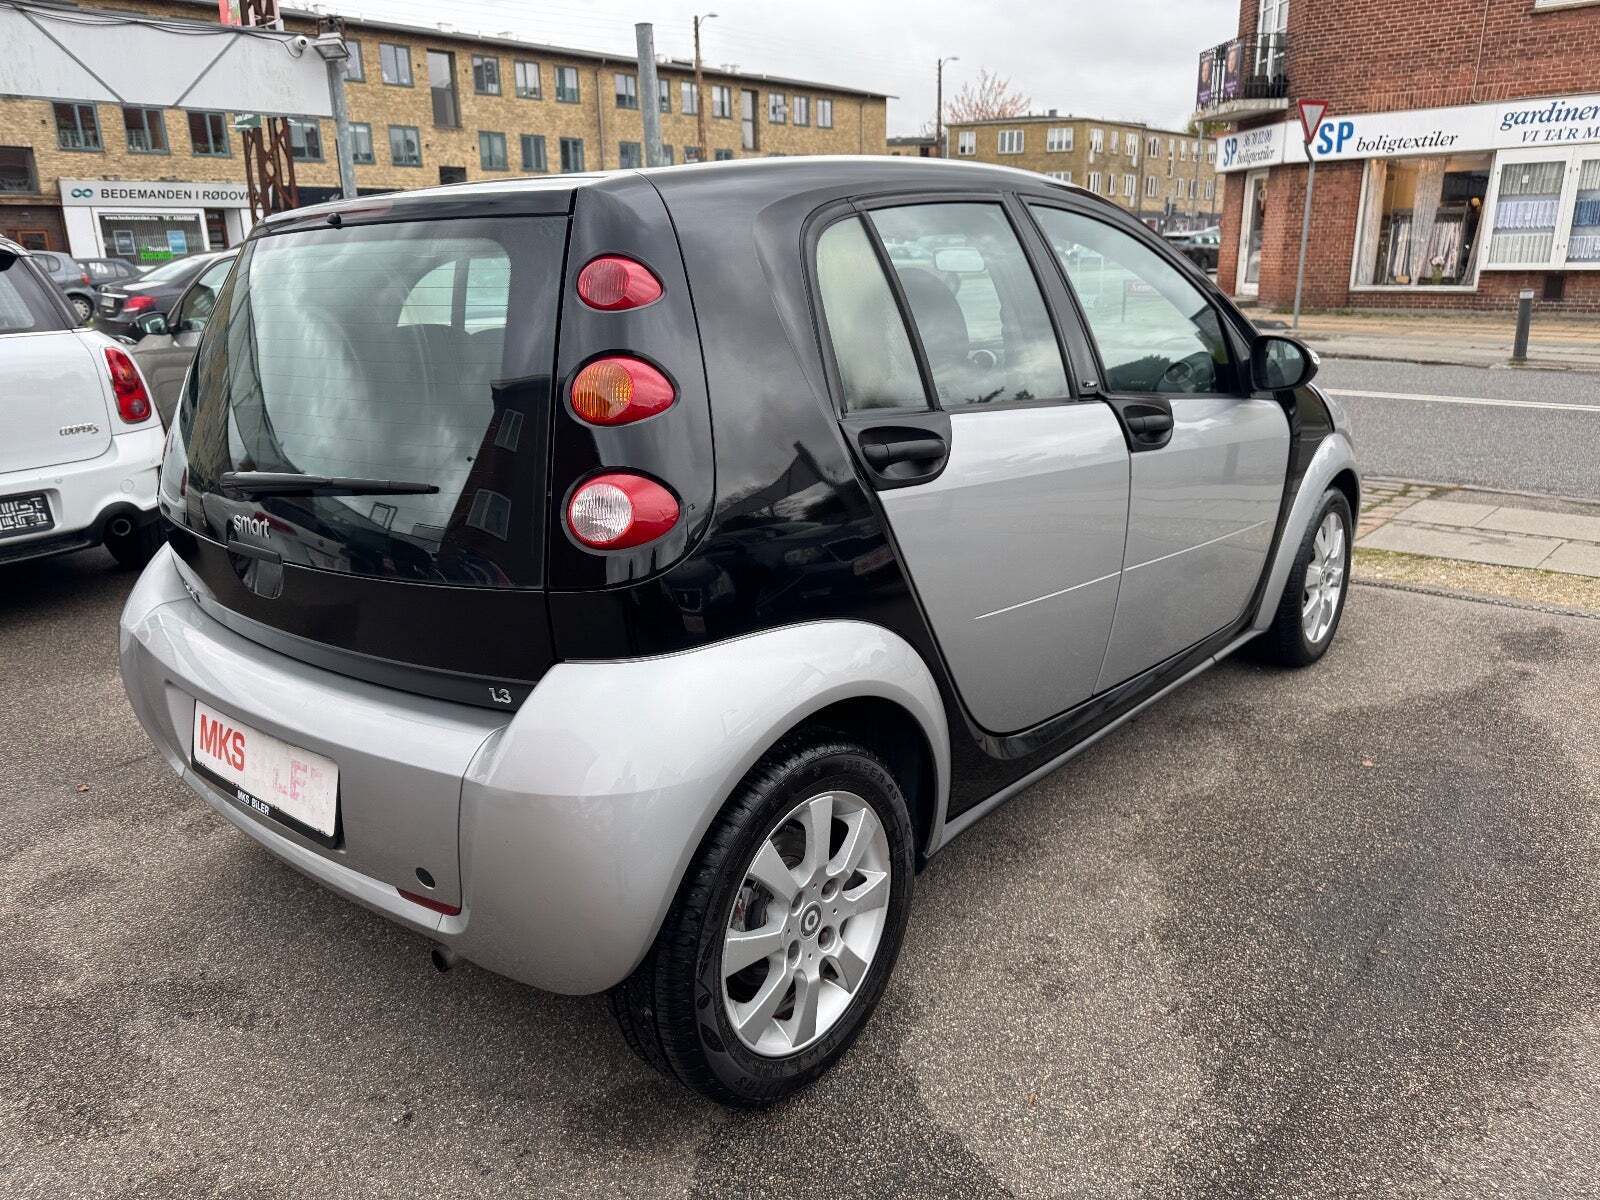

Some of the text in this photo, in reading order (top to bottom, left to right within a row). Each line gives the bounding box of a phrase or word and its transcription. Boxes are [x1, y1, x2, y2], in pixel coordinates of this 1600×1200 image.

[1317, 121, 1459, 155] SP boligtextiler
[1522, 130, 1540, 143] VI
[1223, 138, 1238, 167] SP
[100, 188, 192, 200] BEDEMANDEN
[233, 514, 270, 538] smart
[200, 713, 246, 772] MKS
[237, 789, 270, 816] MKS BILER
